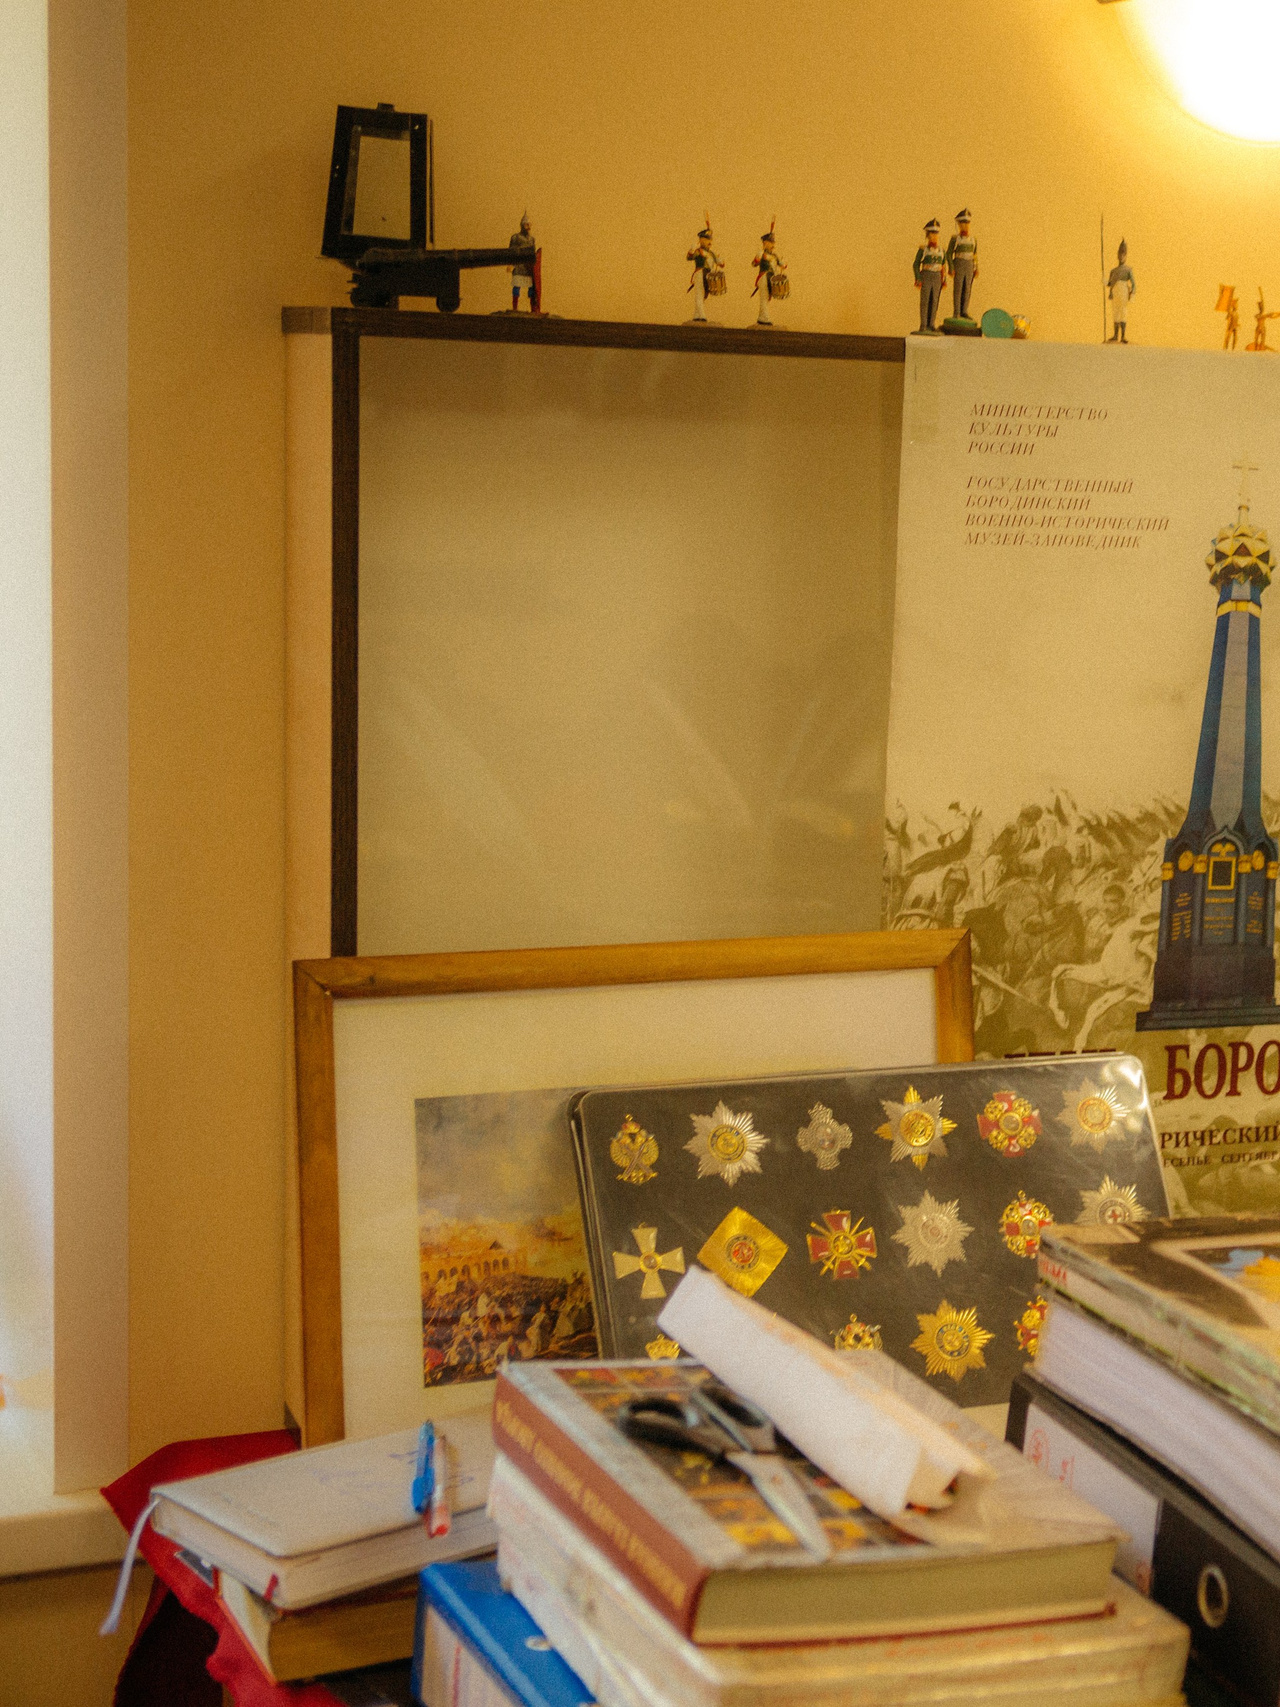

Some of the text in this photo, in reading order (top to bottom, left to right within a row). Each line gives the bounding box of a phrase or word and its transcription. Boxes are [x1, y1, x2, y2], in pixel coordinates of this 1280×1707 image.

[970, 403, 1108, 421] МИНИСТЕРСТВО
[968, 422, 1059, 438] КУЛЬТУРЫ
[967, 441, 1035, 455] РОССИИ
[966, 476, 1134, 494] ГОСУДАРСТВЕННЫЙ
[964, 495, 1090, 511] БОРОДИНСКИЙ
[964, 513, 1169, 531] ВОЕННО-ИСТОРИЧЕСКИЙ
[964, 532, 1142, 550] МУЗЕЙ-ЗАПОВЕДНИК
